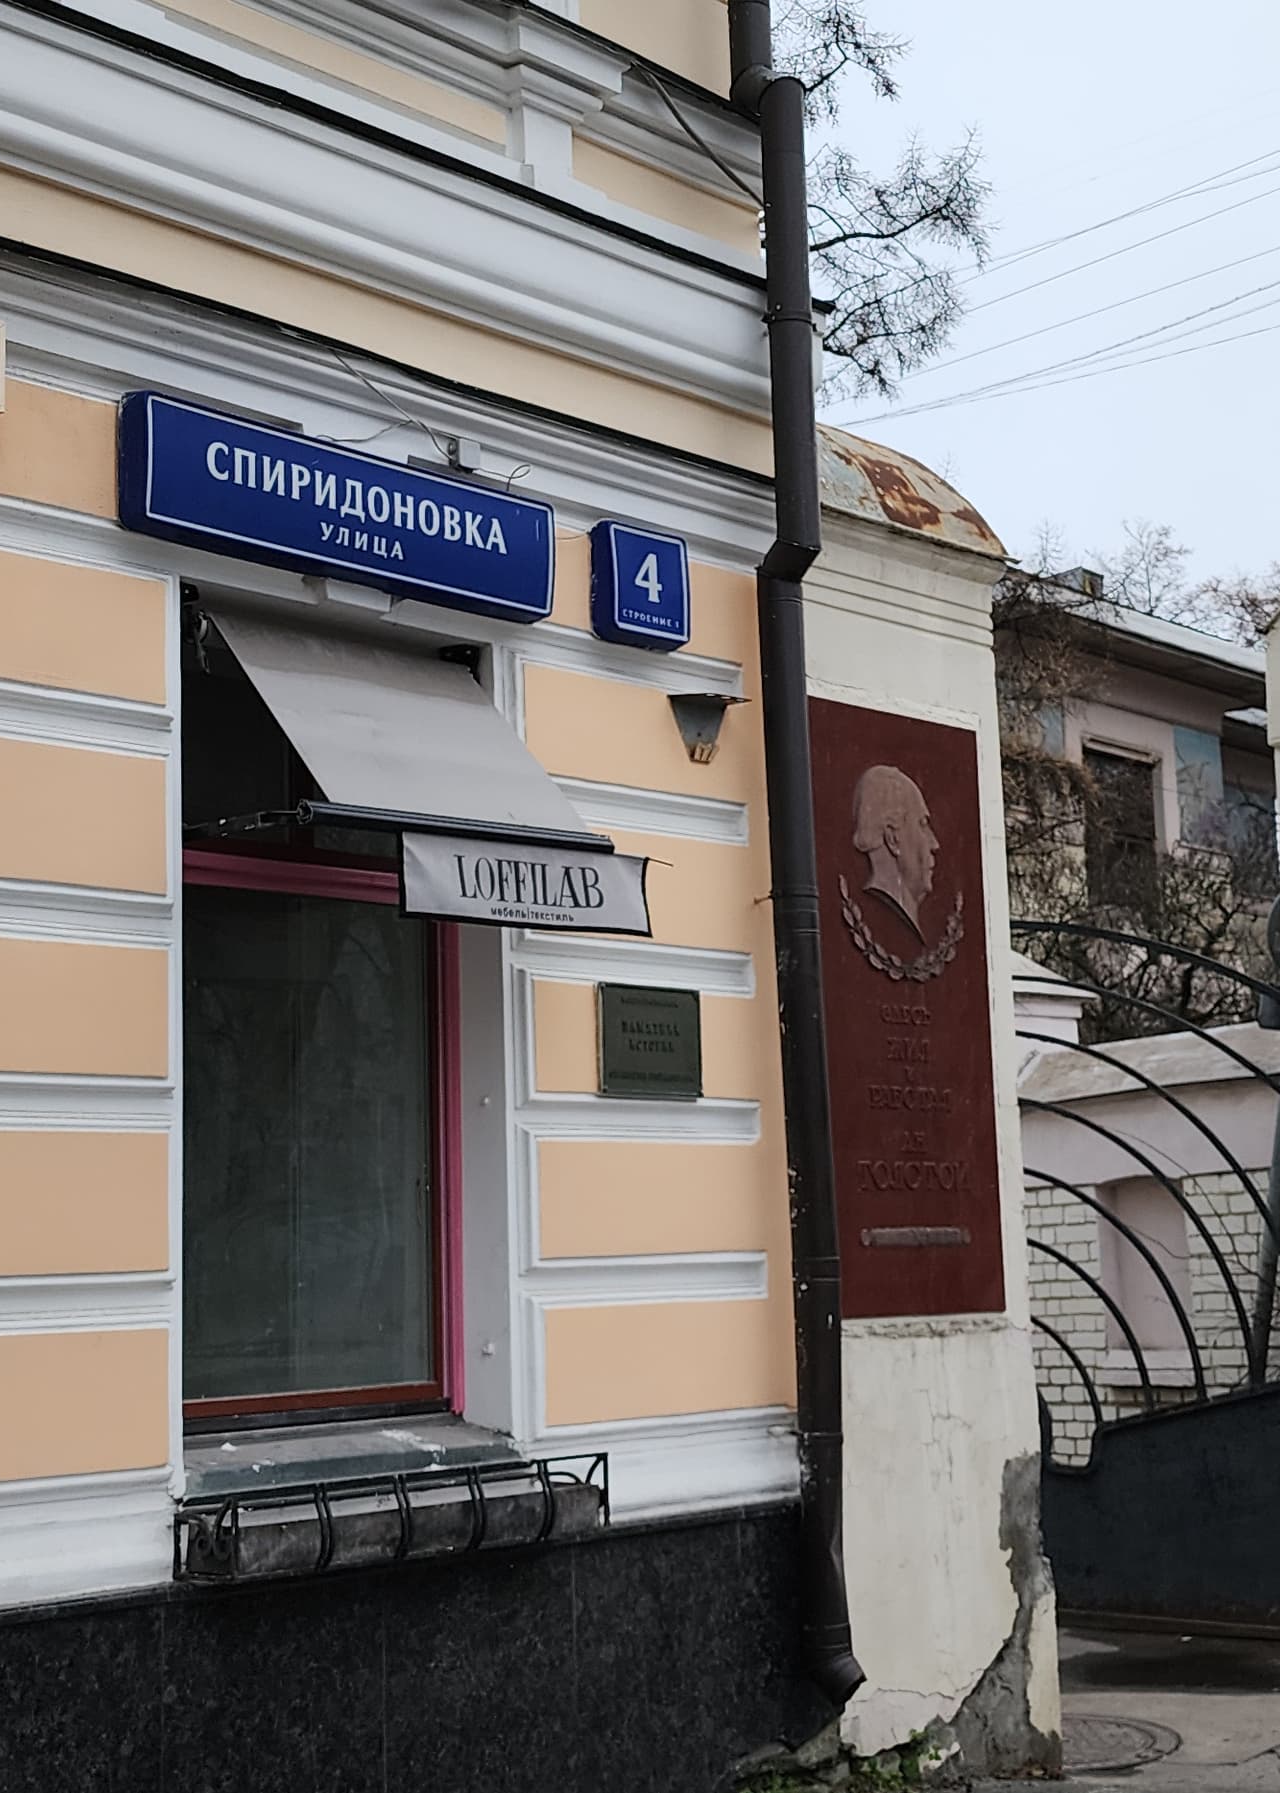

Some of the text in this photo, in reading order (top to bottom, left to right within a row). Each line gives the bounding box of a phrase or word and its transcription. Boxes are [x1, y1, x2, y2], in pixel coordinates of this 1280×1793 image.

[206, 440, 508, 555] СПИРИДОНОВКА
[320, 521, 405, 562] УЛИЦА
[634, 552, 663, 604] 4
[622, 608, 673, 628] СТРОЕНИЕ
[453, 854, 605, 909] LOFFILAB
